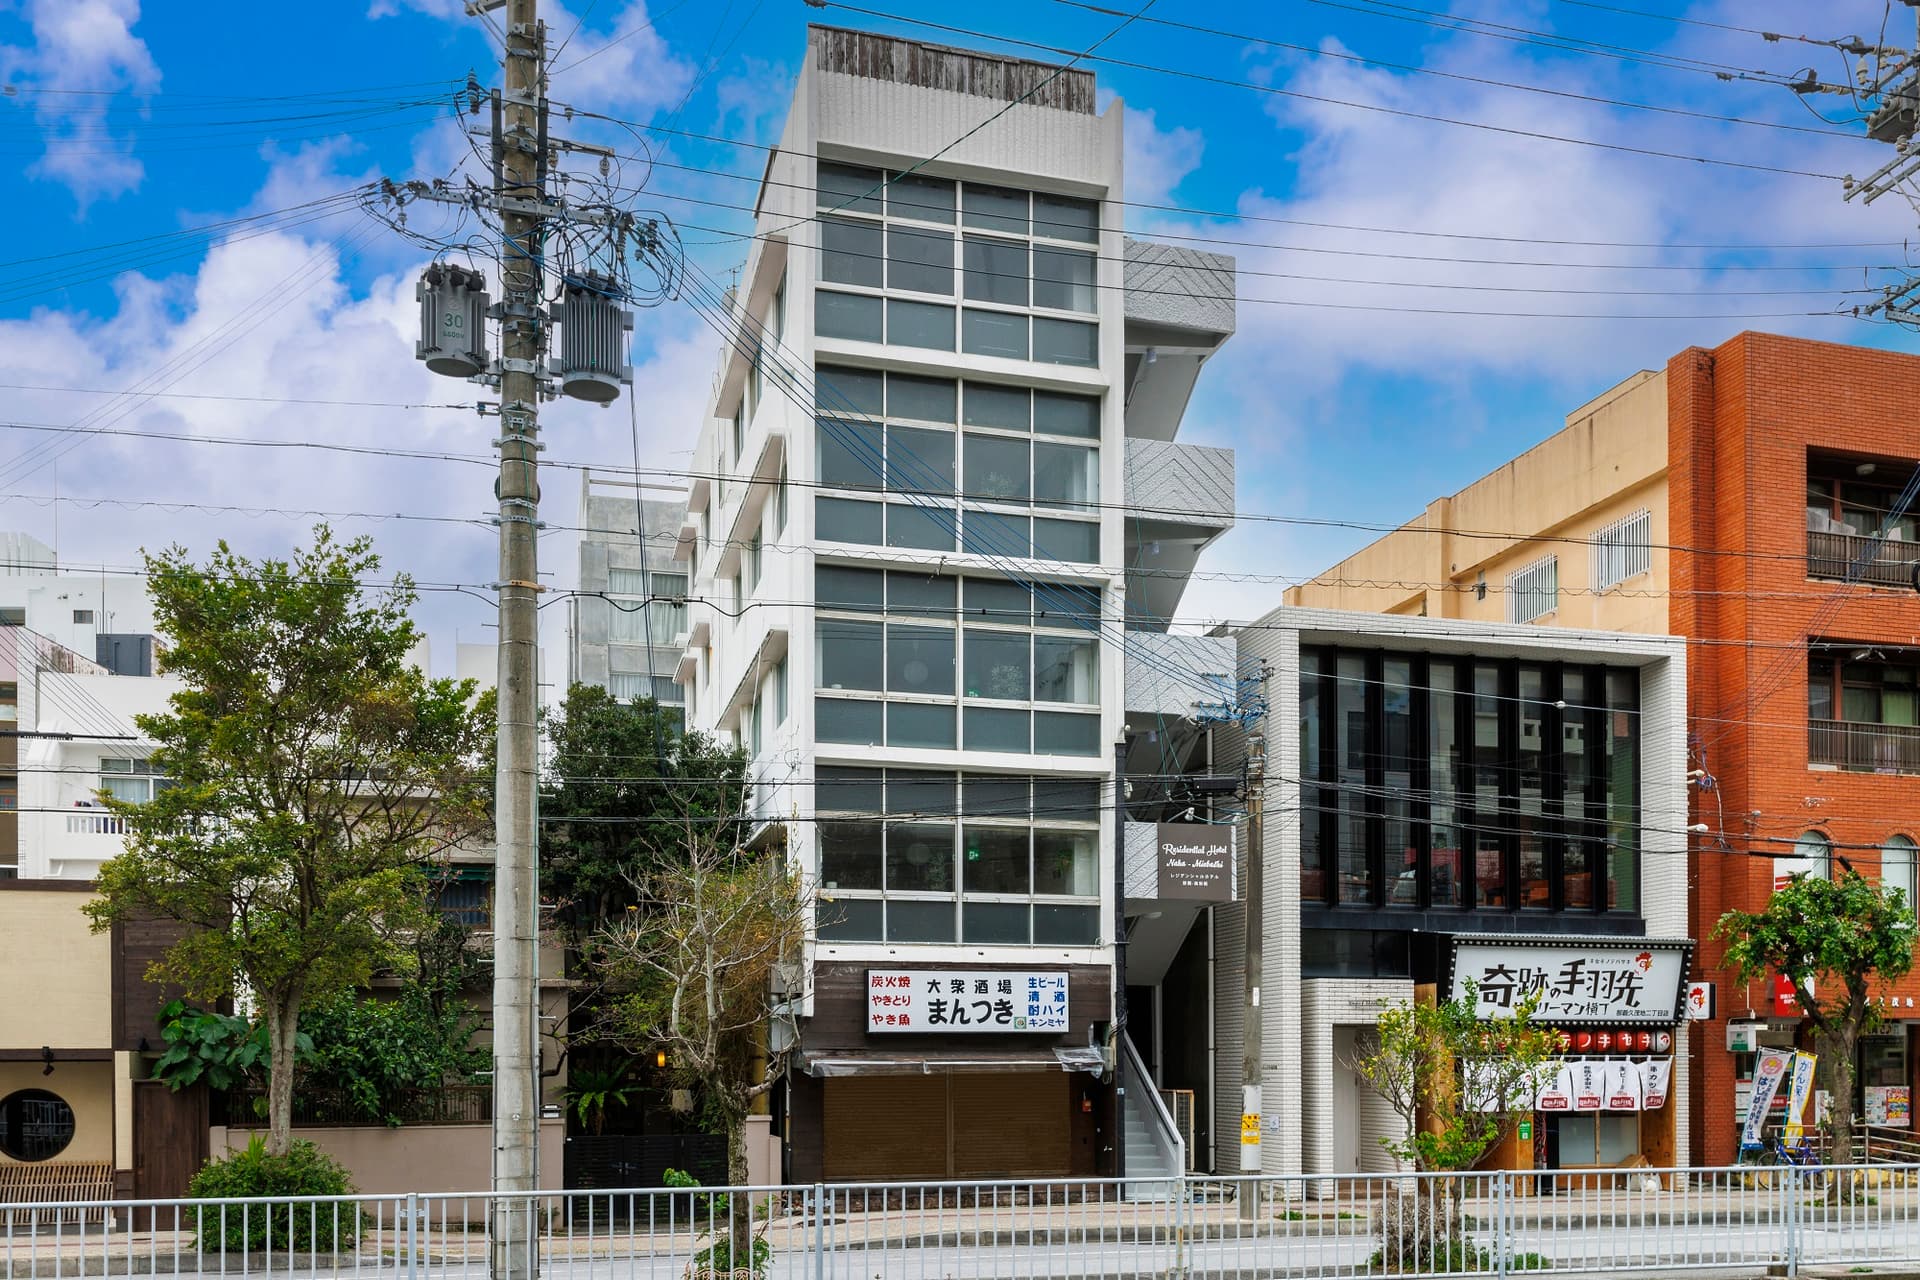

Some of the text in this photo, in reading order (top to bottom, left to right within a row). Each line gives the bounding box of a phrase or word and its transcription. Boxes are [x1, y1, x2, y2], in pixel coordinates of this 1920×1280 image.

[444, 313, 463, 328] 30
[1162, 843, 1227, 856] Residential Hotel
[871, 976, 911, 988] 炭火焼
[927, 979, 1013, 994] 大衆酒場
[1028, 977, 1065, 989] 生ビール
[1479, 958, 1644, 1008] 奇跡の手羽先
[871, 995, 911, 1006] やきとり
[1028, 991, 1065, 1003] 清酒
[927, 998, 1014, 1025] まんつき
[1028, 1005, 1065, 1016] 酎ハイ
[871, 1014, 911, 1026] やき魚
[1028, 1018, 1065, 1027] キンミヤ
